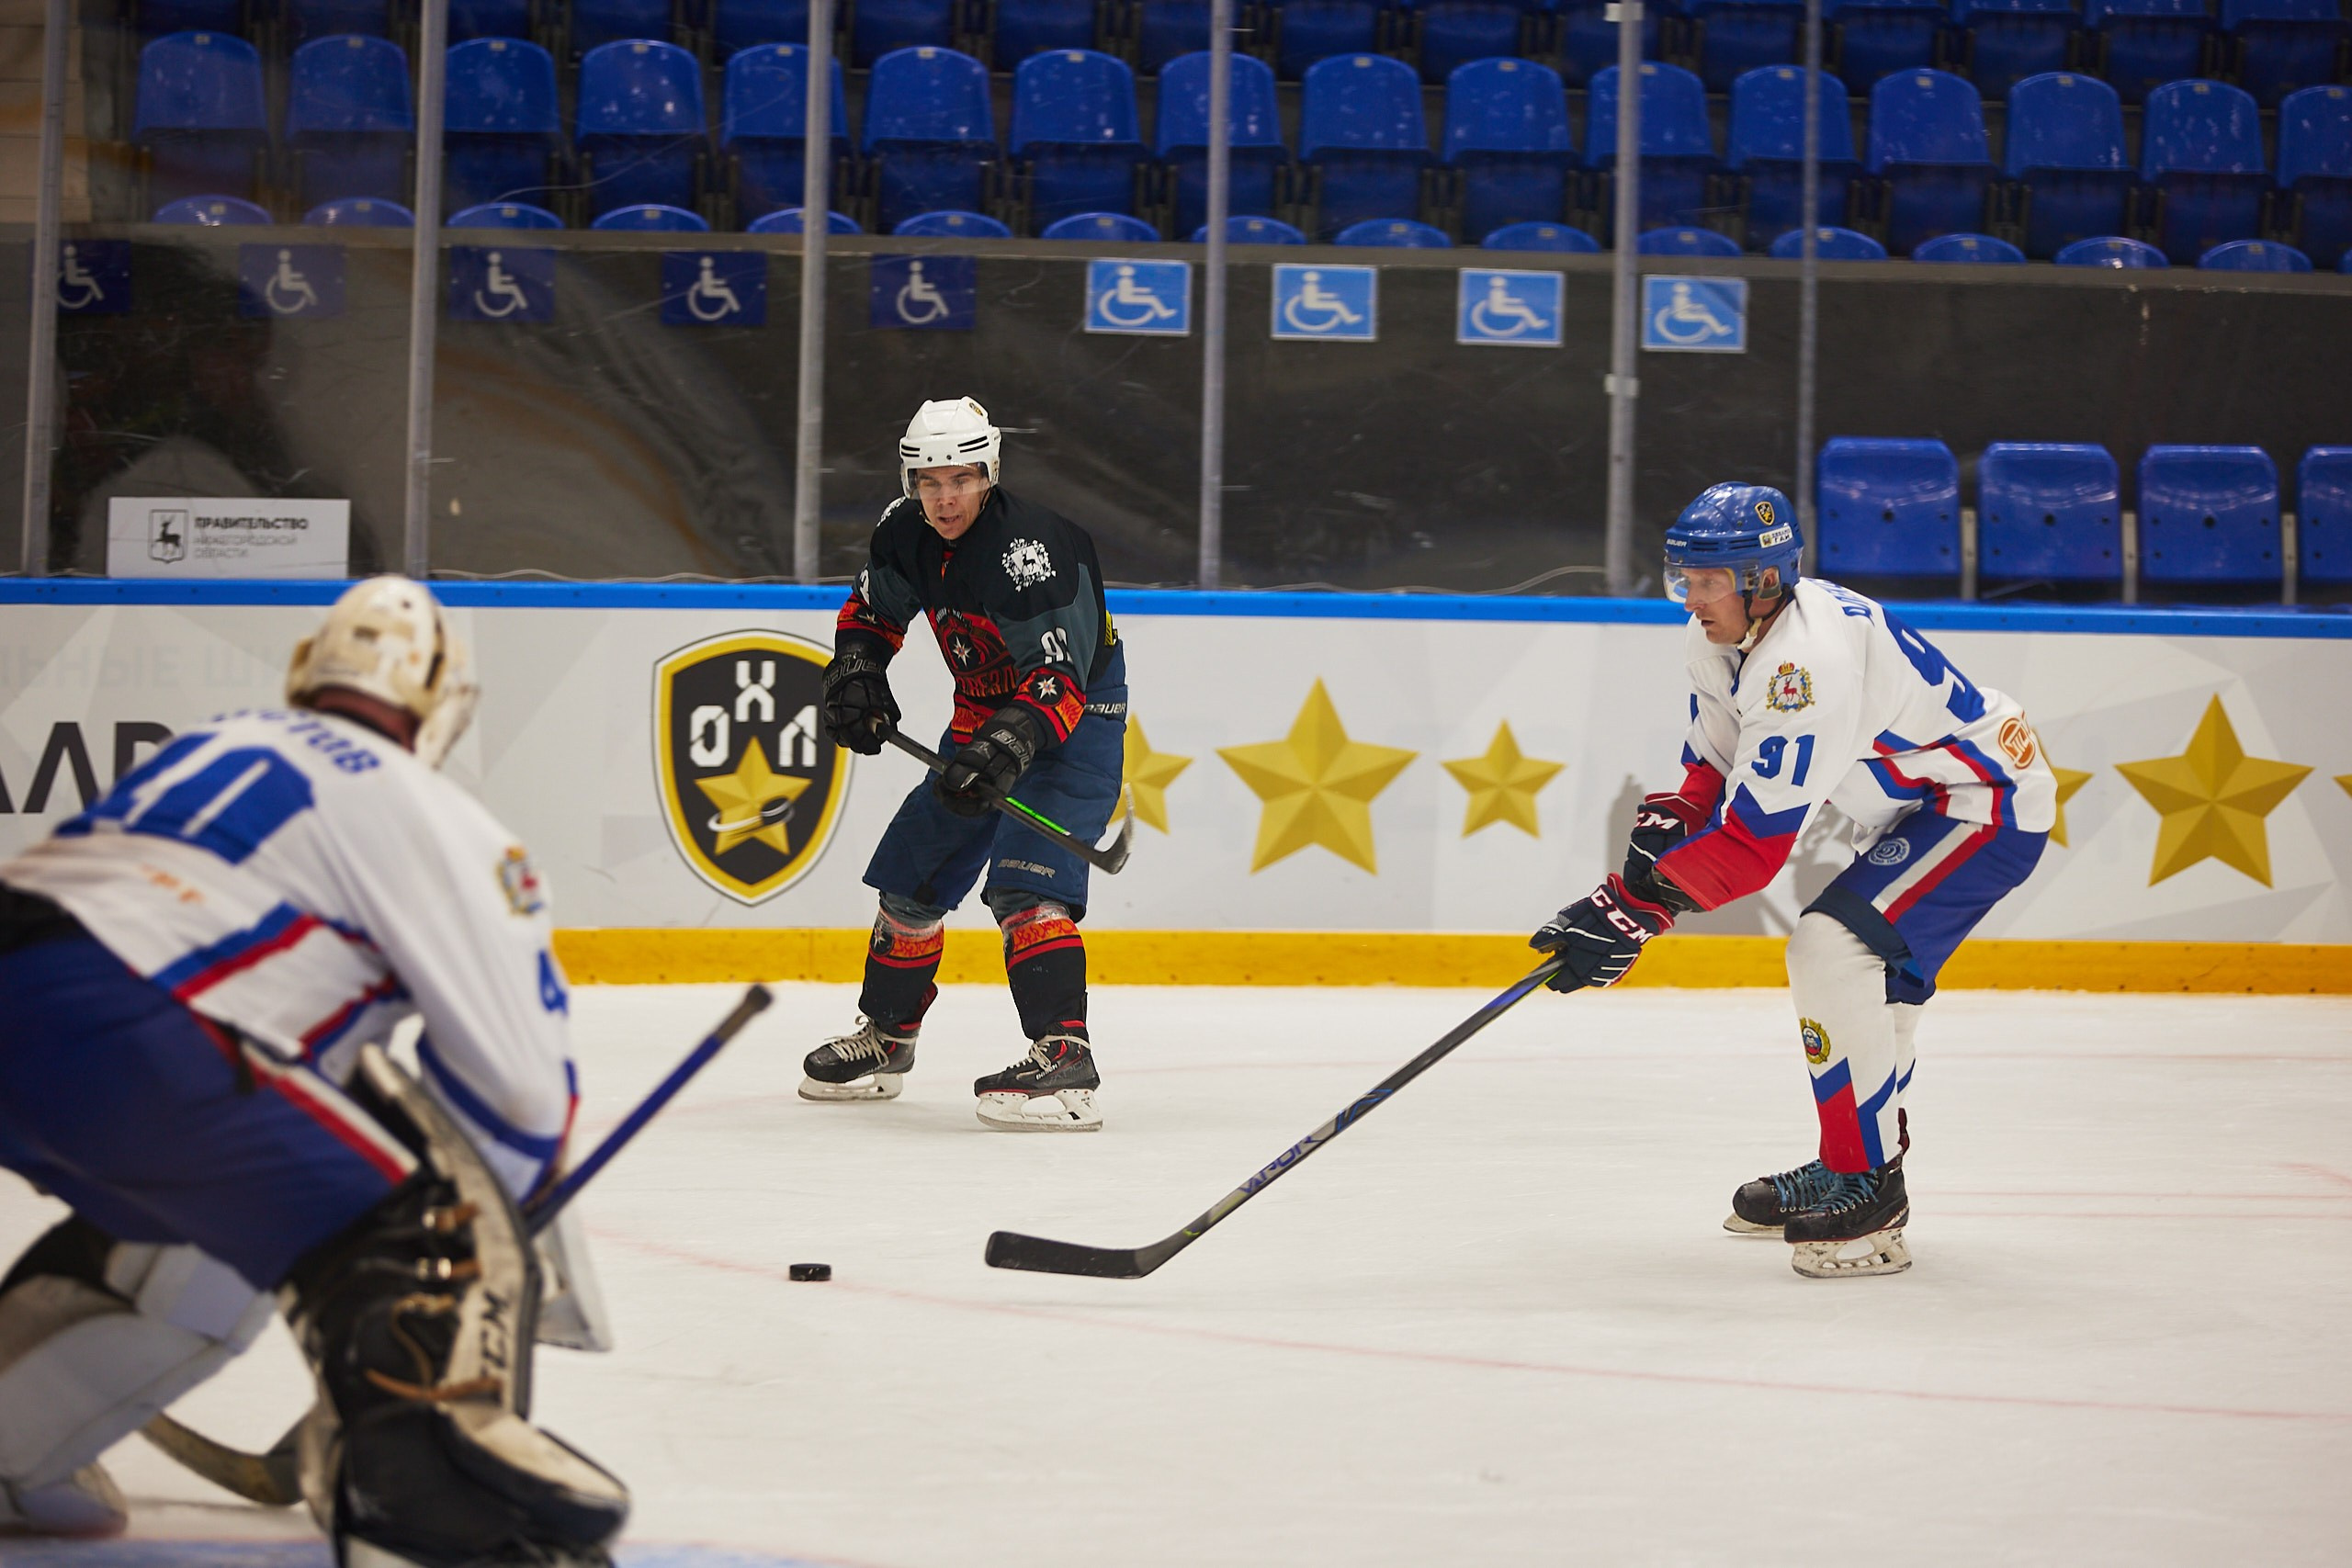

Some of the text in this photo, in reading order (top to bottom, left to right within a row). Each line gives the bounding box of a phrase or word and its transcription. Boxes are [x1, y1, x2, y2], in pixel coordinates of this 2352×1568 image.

[195, 517, 308, 529] ПРАВИТЕЛЬСТВО
[1750, 734, 1815, 787] 91
[1590, 887, 1654, 945] CCM
